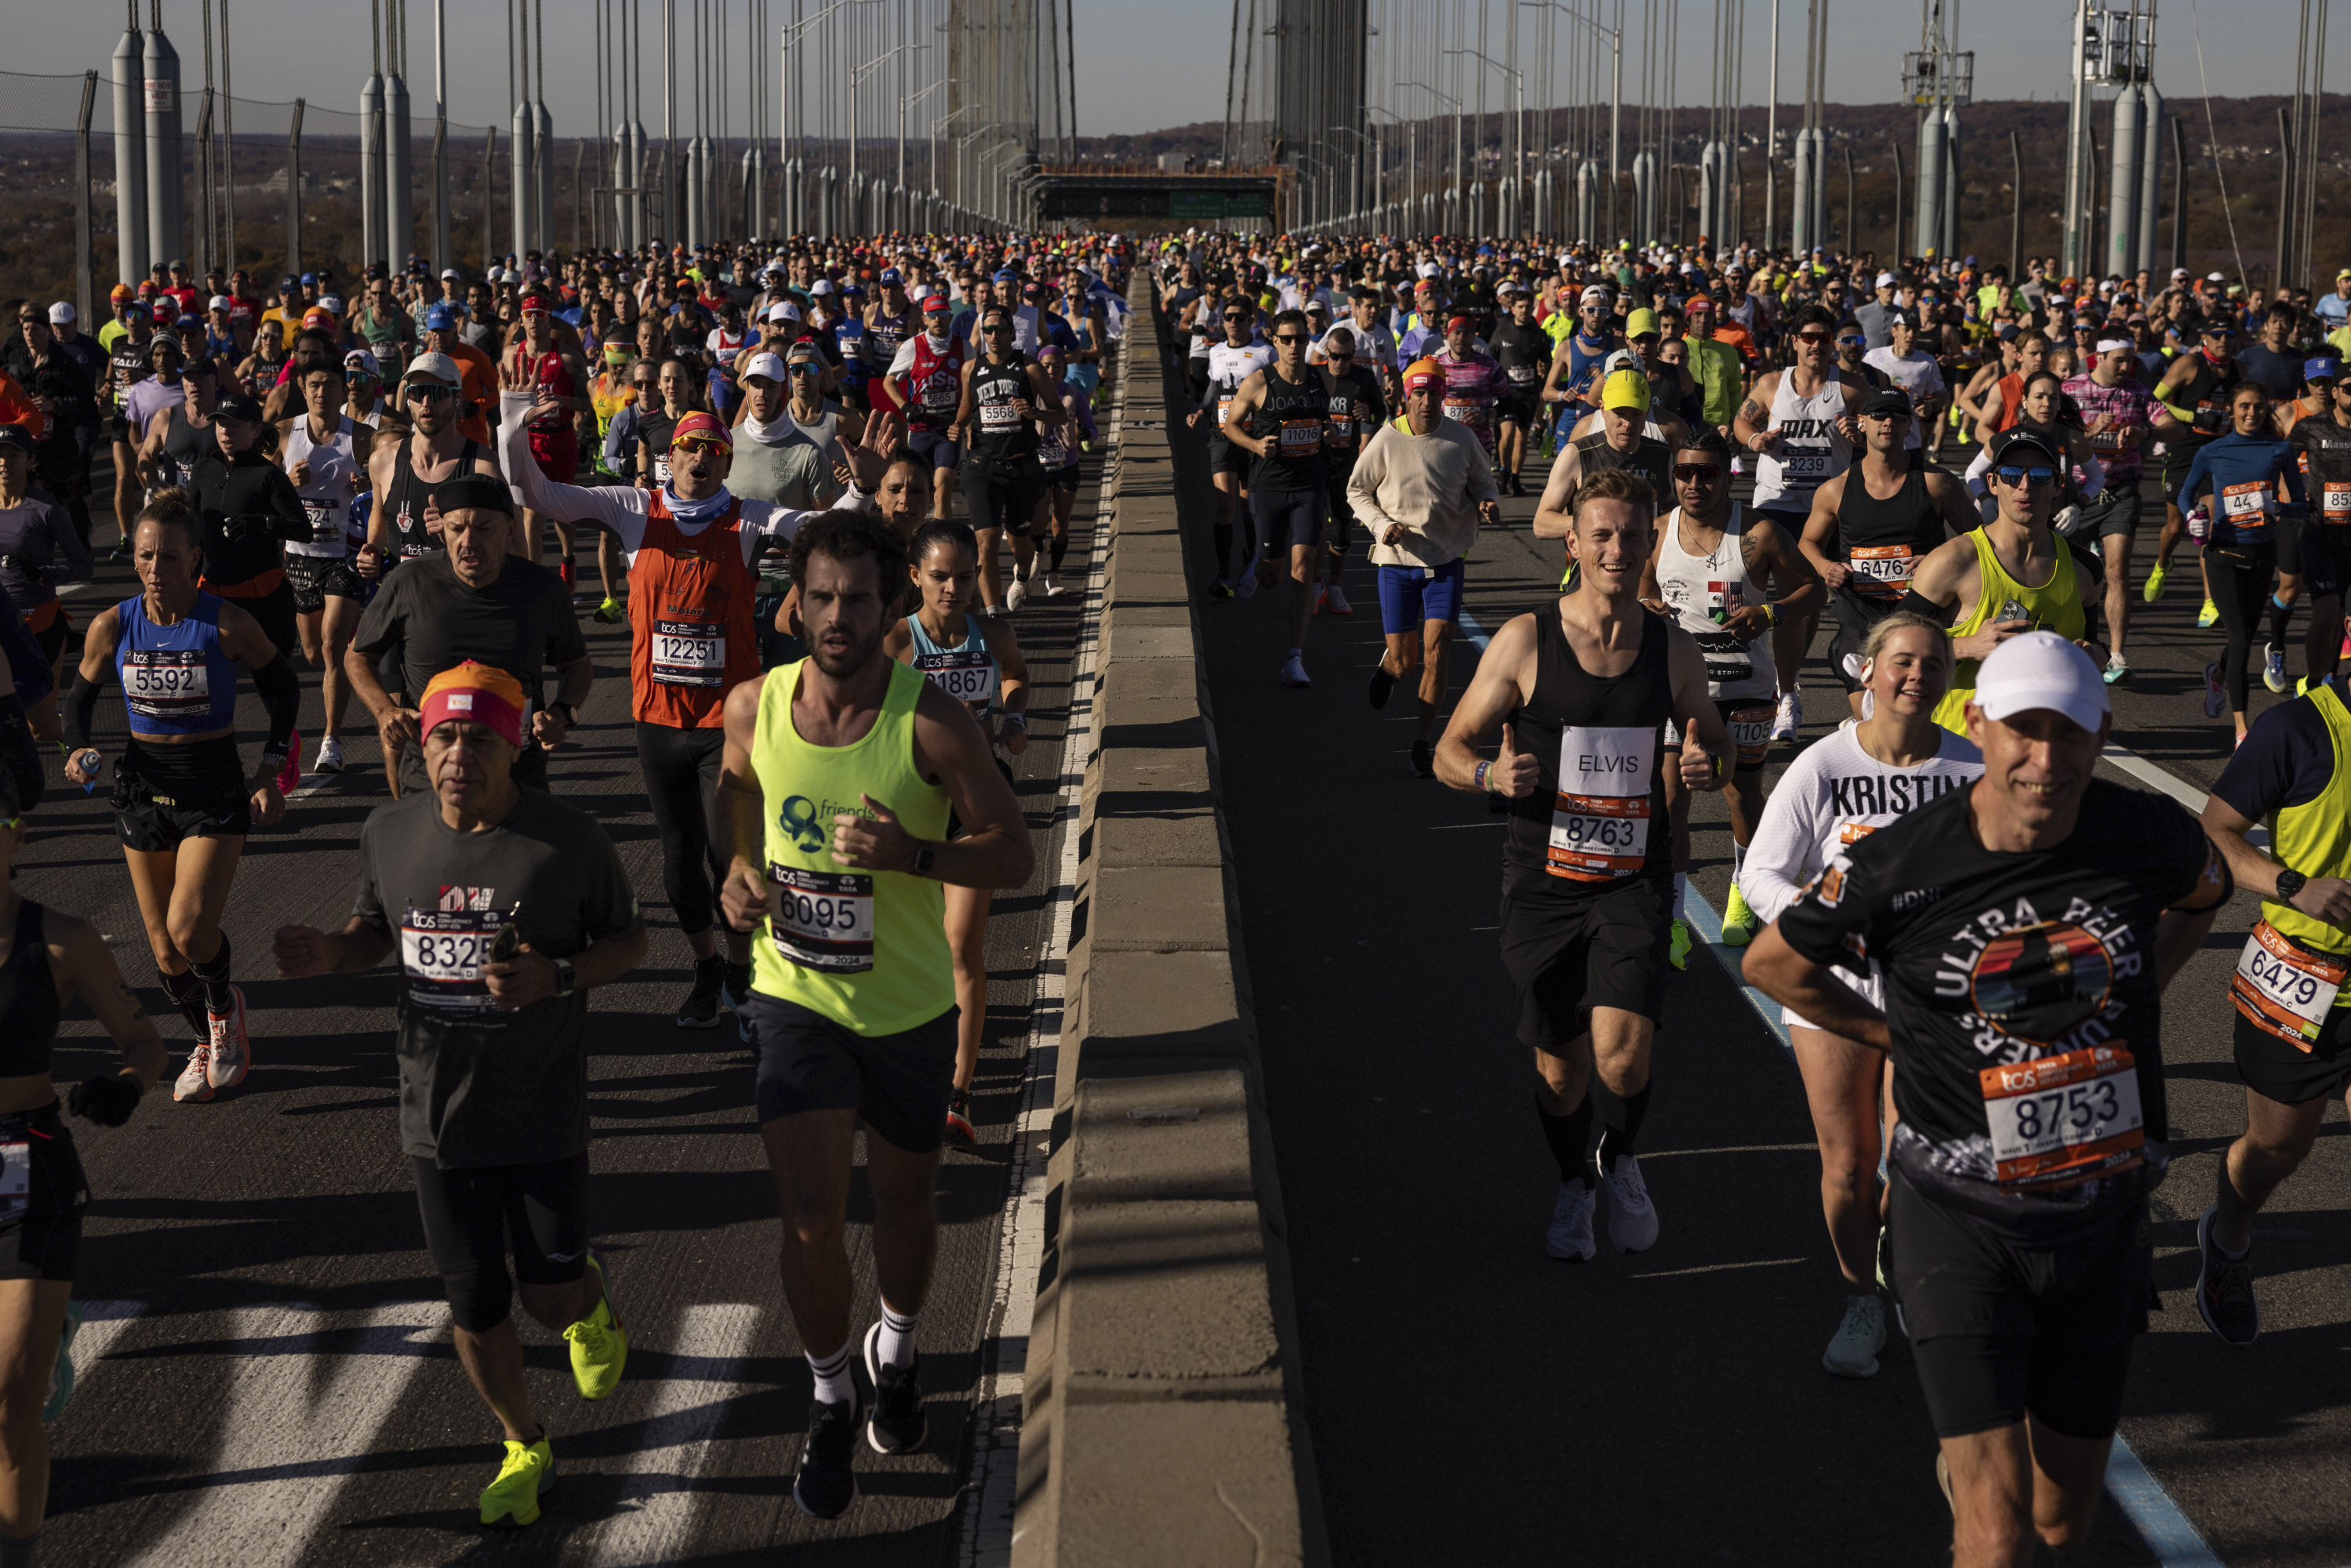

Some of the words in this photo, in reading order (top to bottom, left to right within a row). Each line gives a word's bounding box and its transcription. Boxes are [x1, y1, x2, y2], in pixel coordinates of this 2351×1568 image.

[927, 392, 951, 404] 5665
[977, 381, 995, 400] NEW
[986, 407, 1014, 419] 5568
[1287, 428, 1317, 441] 11016
[1779, 419, 1833, 439] MAX
[1789, 458, 1824, 471] 8239
[1861, 560, 1903, 577] 6476
[667, 605, 710, 616] Molara
[661, 622, 677, 633] tcs
[133, 652, 149, 664] tcs
[661, 637, 716, 661] 12251
[924, 657, 941, 667] tcs
[136, 669, 194, 691] 5592
[1737, 712, 1751, 720] tcs
[1578, 755, 1638, 773] ELVIS
[819, 799, 875, 819] friends
[1567, 797, 1587, 812] tcs
[1566, 817, 1634, 846] 8763
[776, 866, 796, 885] tcs
[781, 890, 856, 930] 6095
[413, 910, 436, 929] tcs
[1934, 896, 2043, 998] ULTRA
[2062, 896, 2142, 981] BEER
[2262, 927, 2278, 949] tcs
[2279, 940, 2290, 951] TATA
[835, 956, 860, 965] 2024
[2251, 950, 2318, 1005] 6479
[2311, 965, 2328, 977] TATA
[2239, 967, 2249, 977] WAVE
[2267, 992, 2286, 1005] CORRAL
[2280, 1024, 2303, 1040] 2024
[2036, 1062, 2057, 1071] TATA
[2095, 1061, 2118, 1072] TATA
[2000, 1070, 2037, 1092] tcs
[2016, 1081, 2119, 1140] 8753
[2001, 1146, 2022, 1156] WAVE
[2093, 1127, 2102, 1136] D
